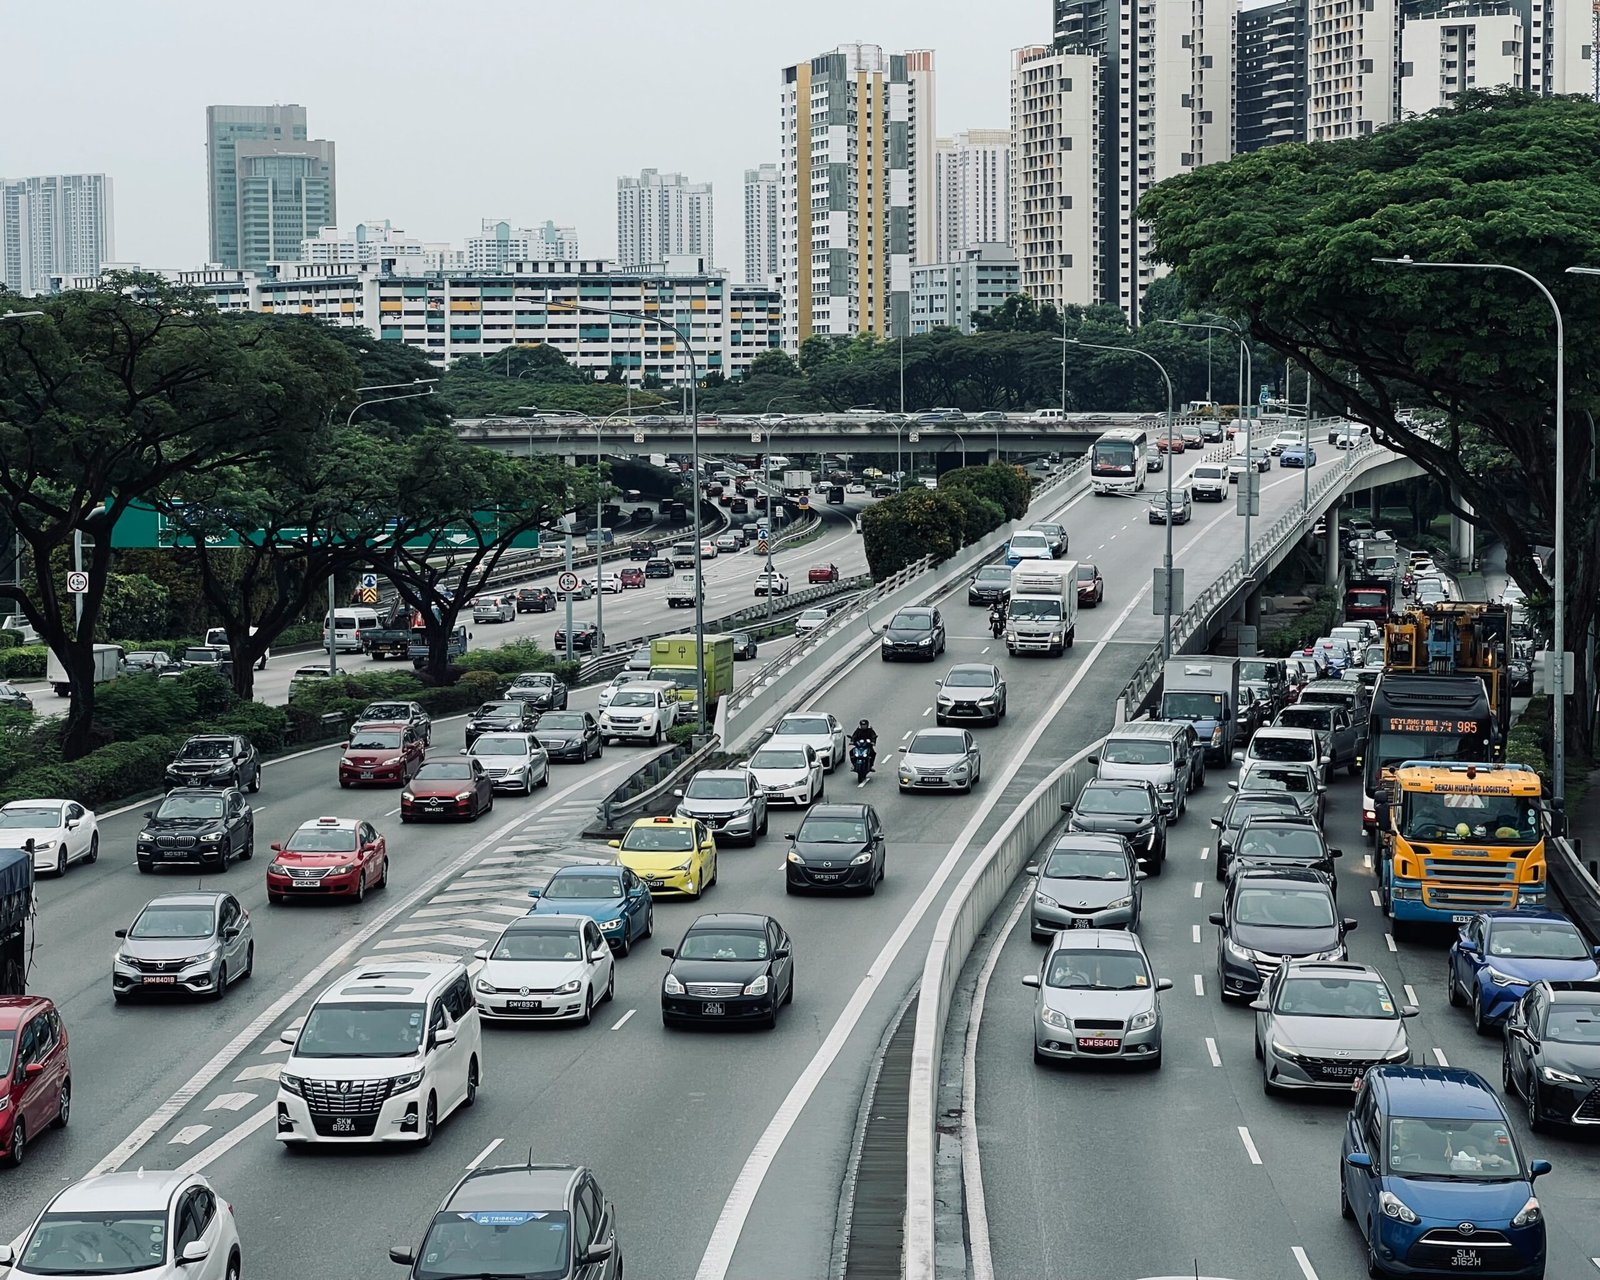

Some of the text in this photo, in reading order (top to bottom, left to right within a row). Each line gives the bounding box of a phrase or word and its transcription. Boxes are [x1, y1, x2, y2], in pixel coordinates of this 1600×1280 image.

[1457, 721, 1477, 734] 985
[1434, 784, 1454, 792] DENZAI
[1483, 786, 1510, 794] LOGISTICS
[1322, 1066, 1364, 1075] SKU5757B
[1456, 1249, 1476, 1257] SLW
[1451, 1257, 1481, 1266] 3162H
